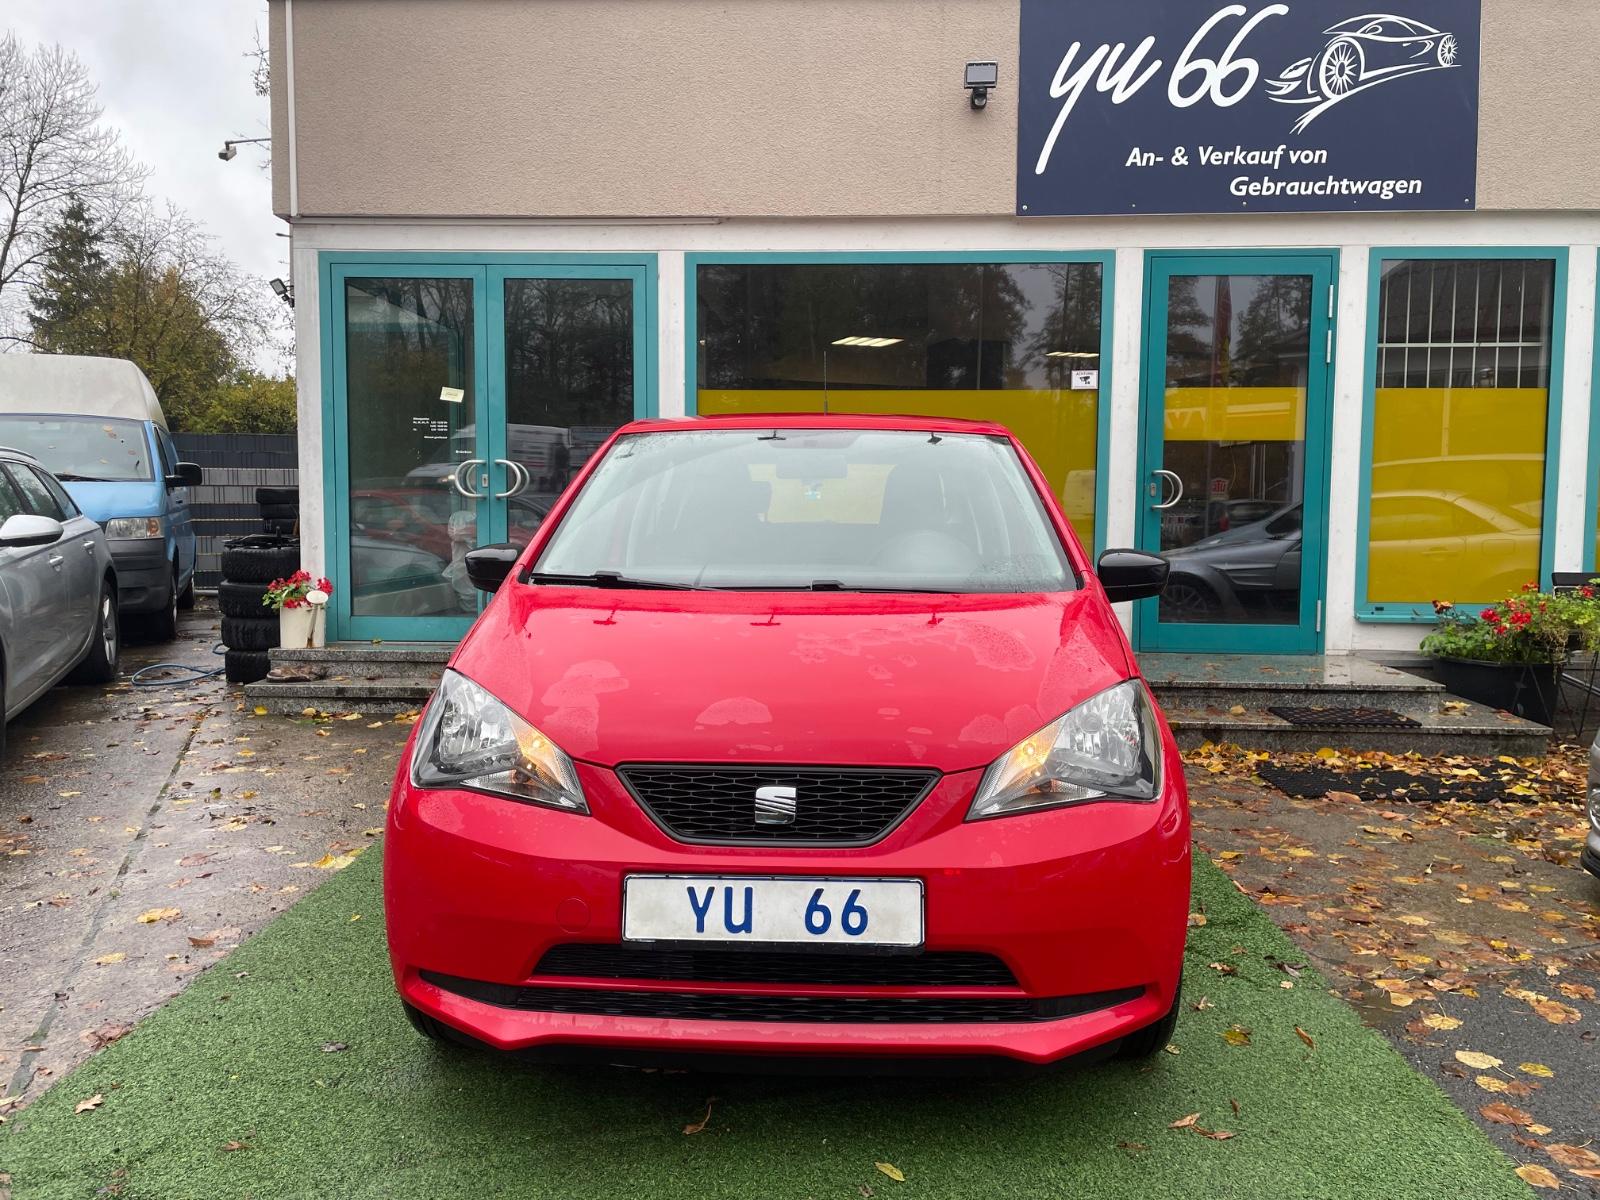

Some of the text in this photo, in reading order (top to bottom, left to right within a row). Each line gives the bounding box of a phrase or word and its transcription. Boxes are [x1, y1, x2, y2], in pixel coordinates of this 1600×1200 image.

[1168, 3, 1290, 108] 66
[1124, 144, 1328, 170] An- & Verkauf von
[1229, 176, 1422, 200] Gebrauchtwagen
[686, 885, 869, 936] YU 66
